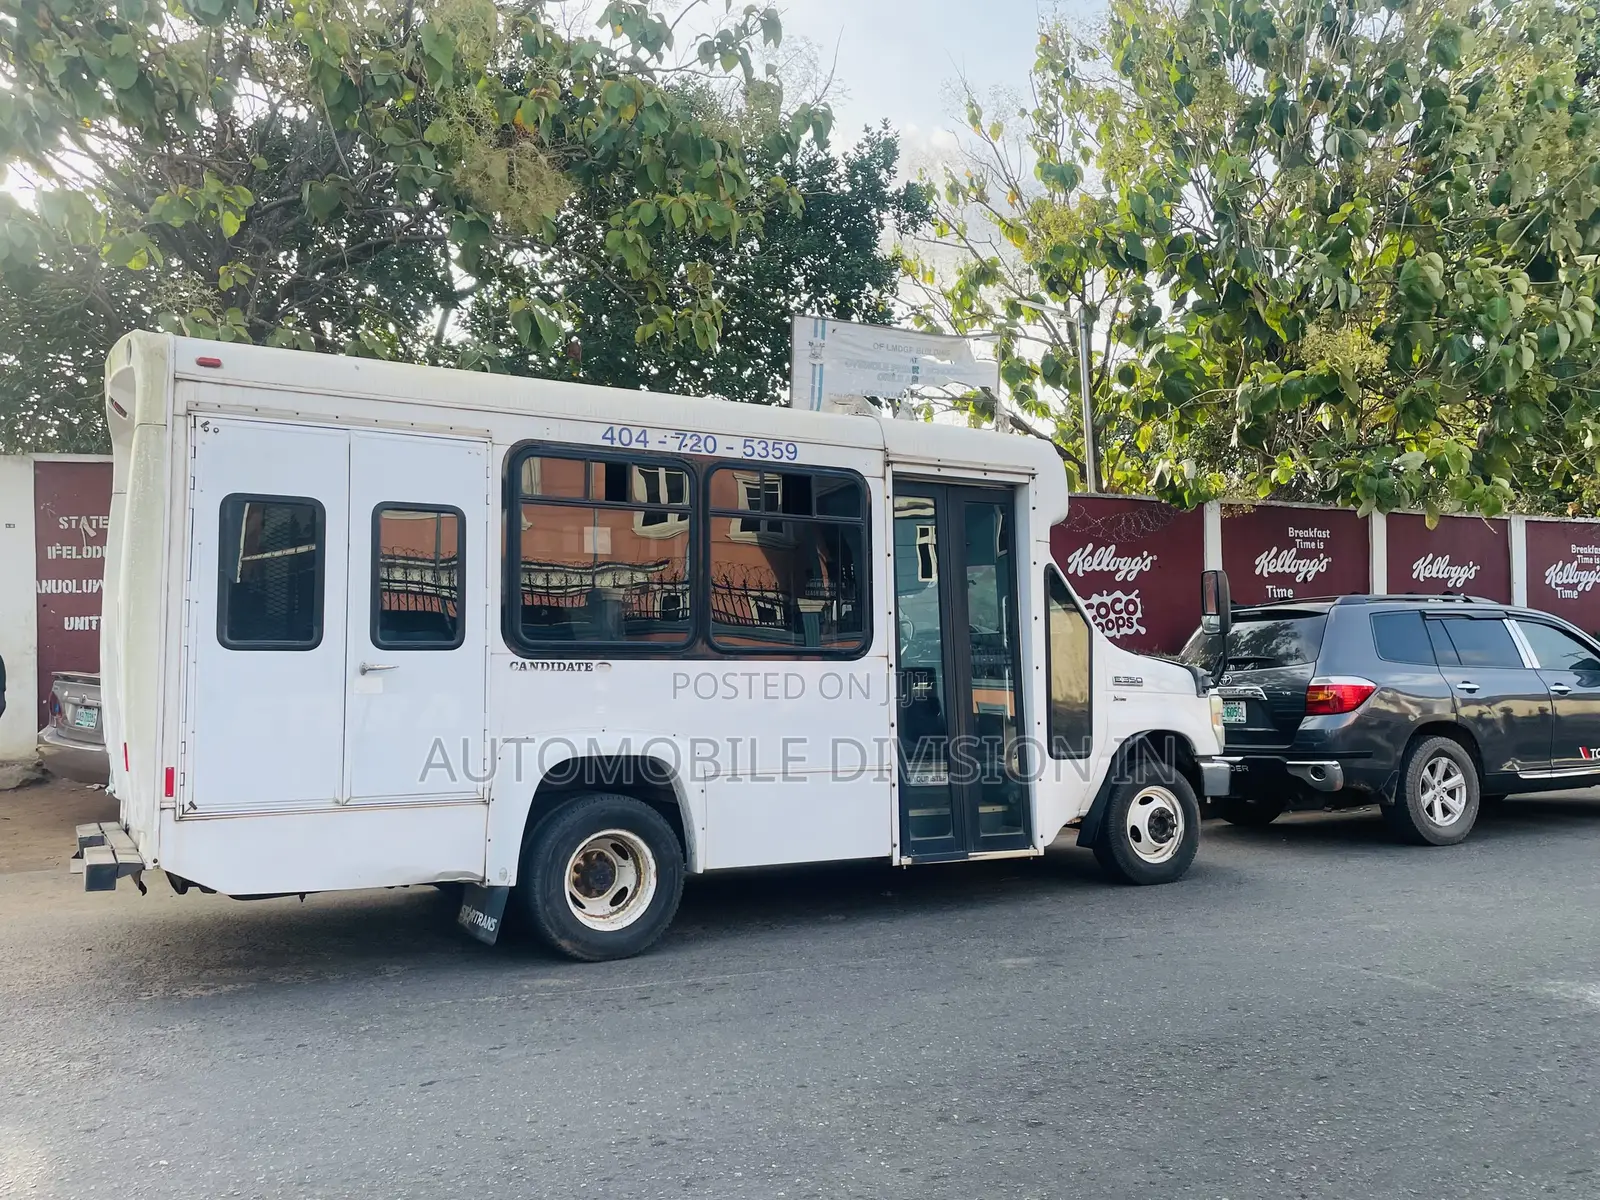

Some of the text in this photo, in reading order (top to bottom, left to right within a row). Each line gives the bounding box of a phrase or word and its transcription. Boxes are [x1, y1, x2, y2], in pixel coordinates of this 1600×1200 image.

[601, 426, 649, 448] 404
[674, 432, 717, 454] 720
[743, 439, 798, 461] 5359
[59, 516, 109, 529] STATE
[1288, 527, 1330, 539] Breakfast
[1295, 539, 1324, 550] Time is
[1067, 543, 1152, 582] Kellogg's
[1254, 546, 1328, 583] Kellogg's
[1577, 555, 1593, 564] Time
[1412, 553, 1477, 588] Kellogg's
[1266, 585, 1294, 598] Time
[1556, 587, 1578, 599] Time
[64, 616, 102, 630] UNIT
[509, 661, 593, 672] CANDIDATE
